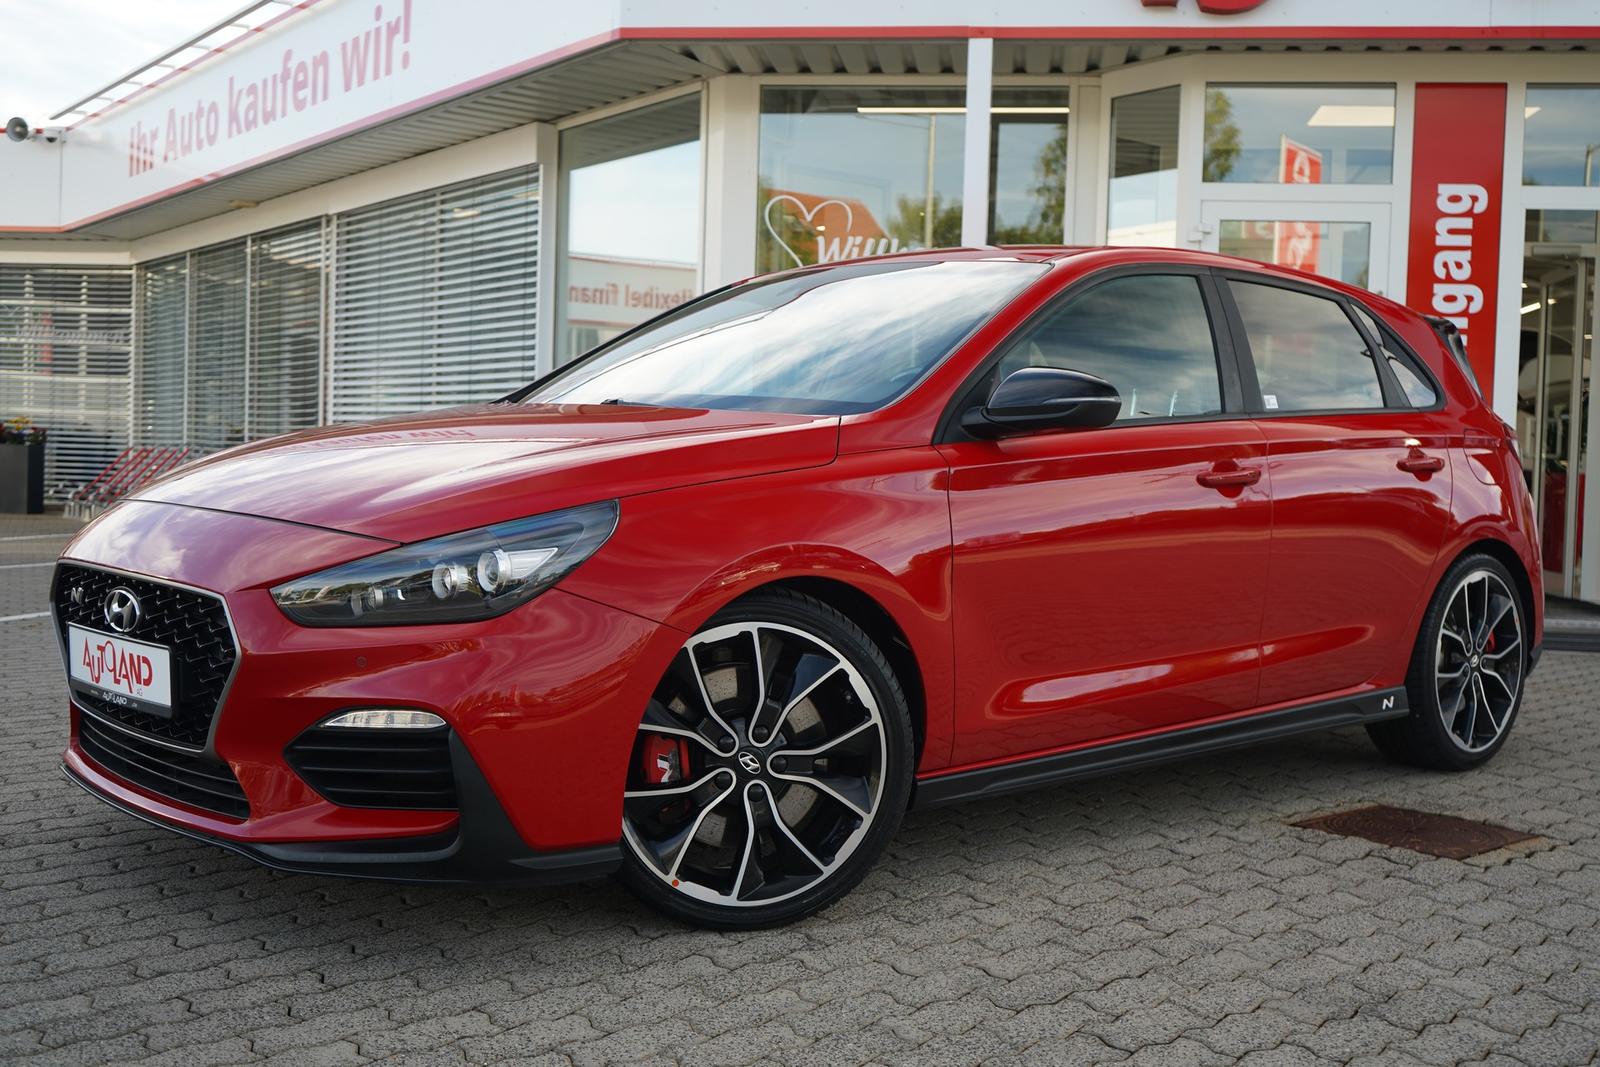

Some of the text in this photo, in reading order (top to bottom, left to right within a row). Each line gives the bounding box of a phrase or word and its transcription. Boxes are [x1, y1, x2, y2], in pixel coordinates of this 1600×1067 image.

[128, 0, 412, 177] Ihr Auto kaufen wir!
[1382, 695, 1395, 710] N
